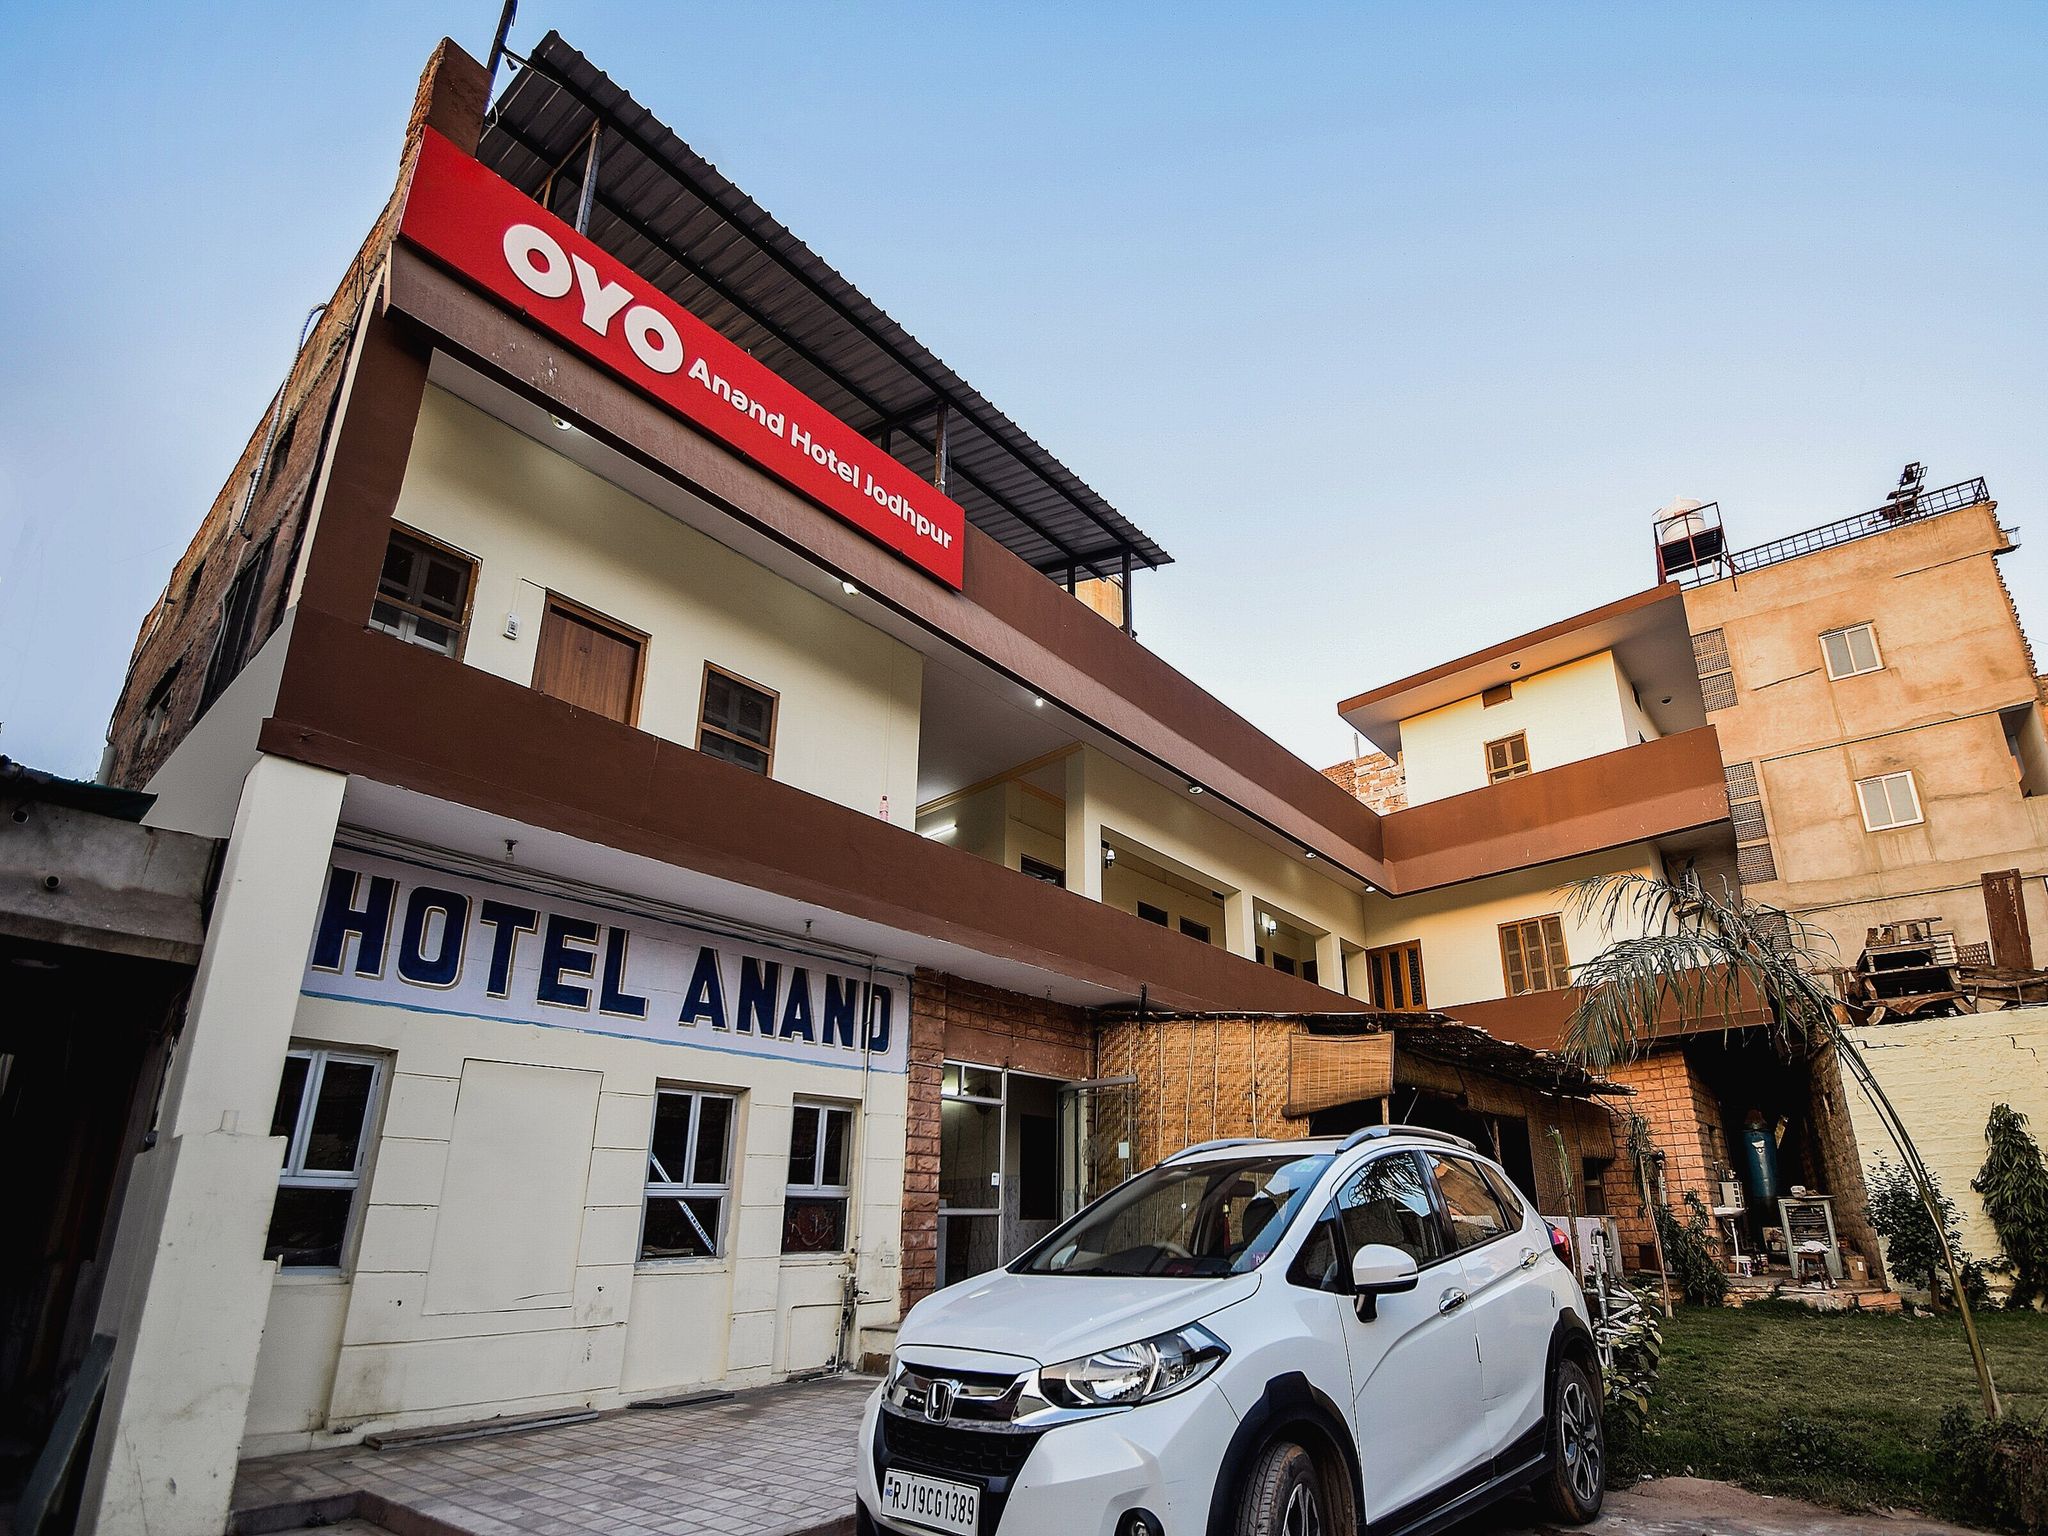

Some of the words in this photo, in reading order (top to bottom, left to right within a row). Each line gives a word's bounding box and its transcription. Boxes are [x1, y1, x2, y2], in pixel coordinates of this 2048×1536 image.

[503, 223, 685, 375] OYO
[687, 357, 785, 438] Anand
[790, 422, 860, 489] Hotel
[863, 474, 953, 549] Jodhpur
[312, 864, 650, 1021] HOTEL
[677, 946, 893, 1056] ANAND
[892, 1481, 975, 1525] RJ19CG1389
